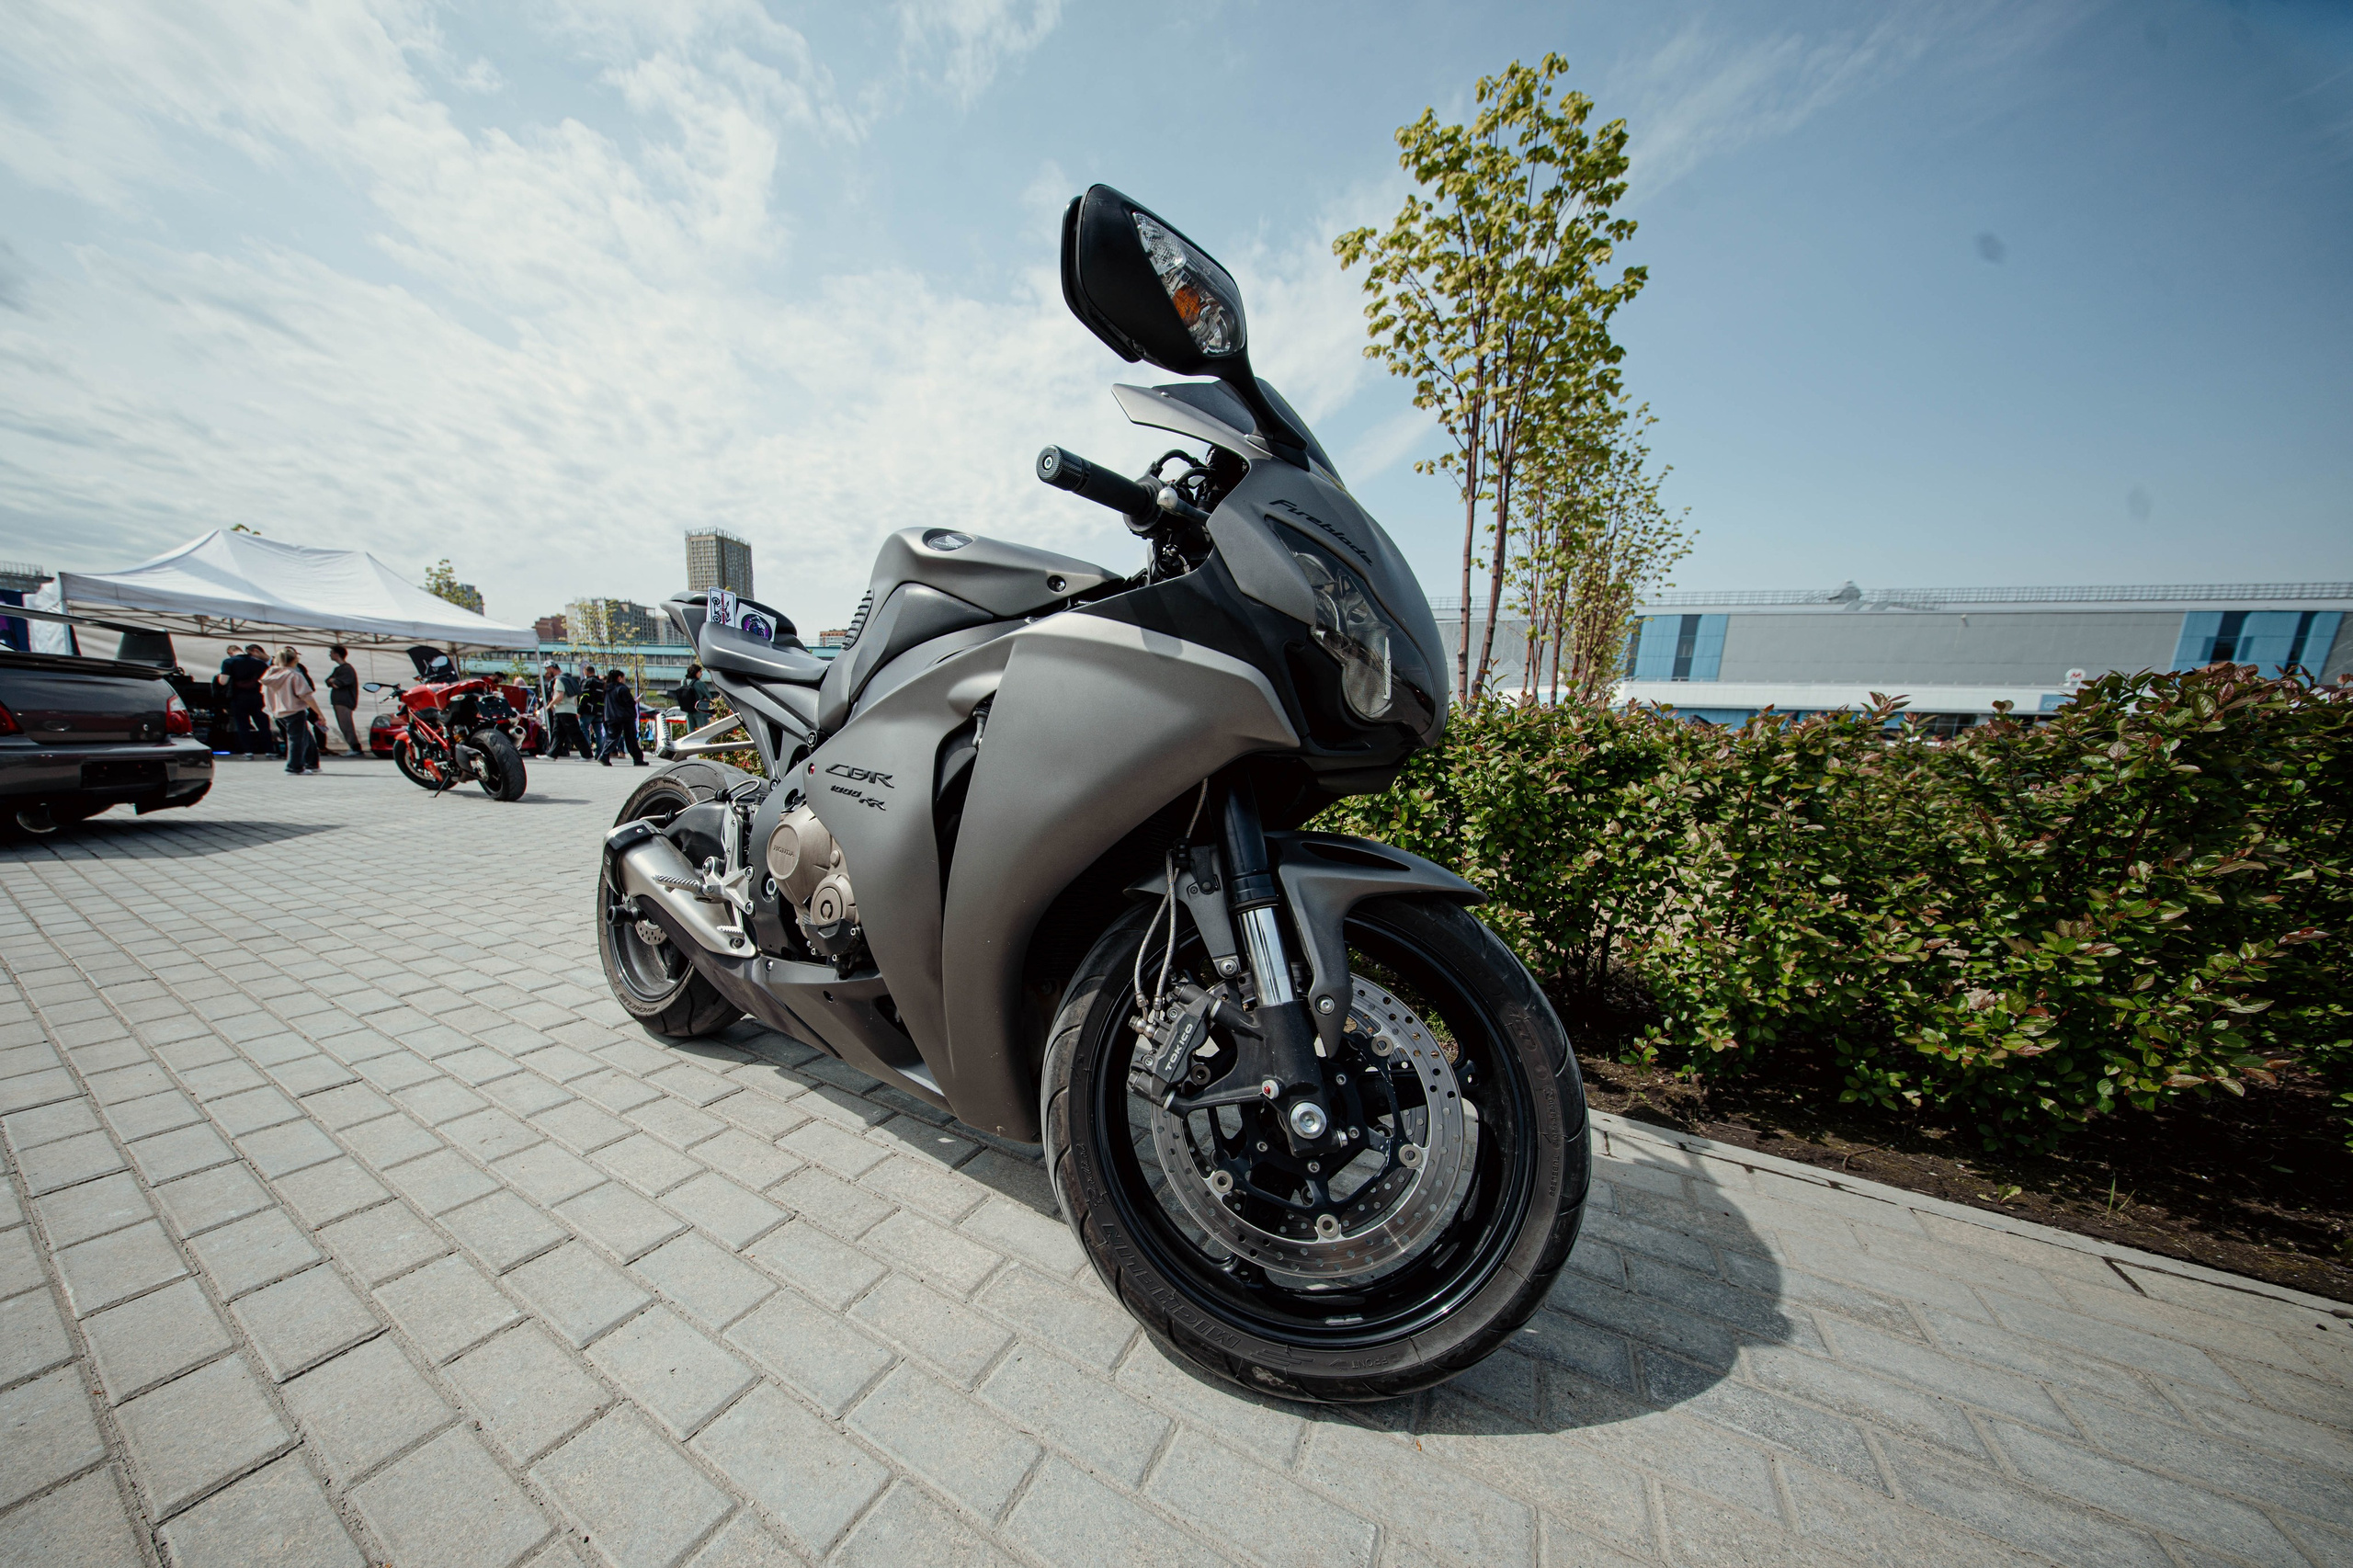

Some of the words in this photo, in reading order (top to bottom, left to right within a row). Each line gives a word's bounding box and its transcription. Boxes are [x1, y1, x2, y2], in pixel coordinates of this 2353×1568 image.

[1268, 499, 1372, 567] Fireblade
[825, 763, 894, 789] CBR
[830, 785, 862, 798] 1000
[858, 796, 886, 811] RR
[773, 845, 795, 858] HONDA
[619, 994, 659, 1013] MICHELIN
[1165, 1023, 1193, 1071] TOKICO
[1548, 1154, 1560, 1198] TUBELESS
[1102, 1223, 1242, 1349] MICHELIN
[1351, 1358, 1390, 1369] FRONT
